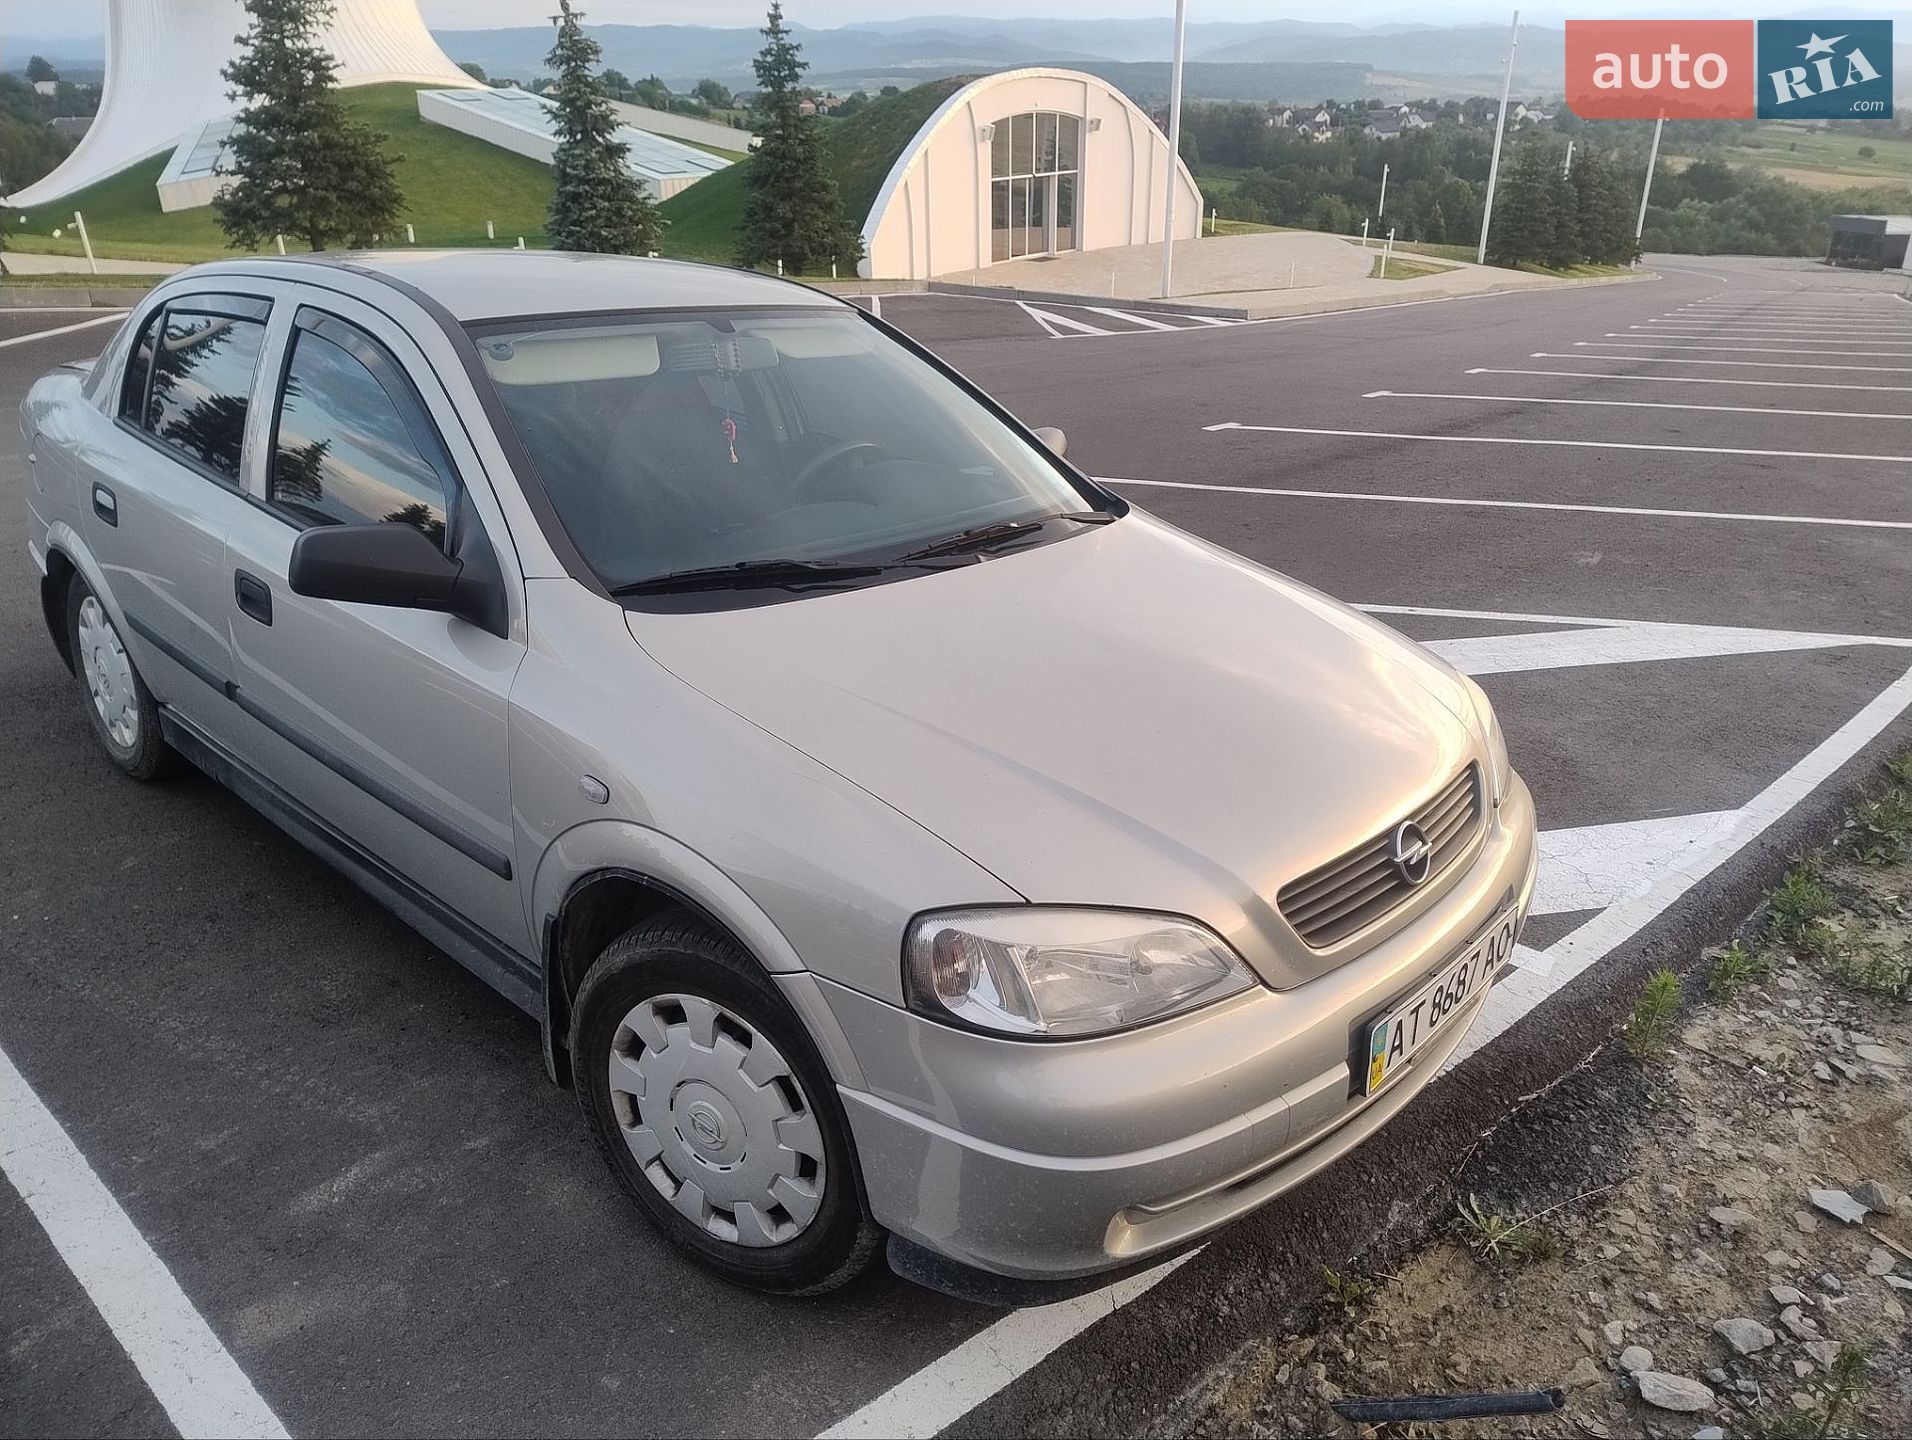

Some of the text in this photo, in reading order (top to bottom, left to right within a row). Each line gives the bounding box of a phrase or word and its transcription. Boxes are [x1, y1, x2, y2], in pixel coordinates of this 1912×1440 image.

[1386, 922, 1513, 1068] AT 8687 AO
